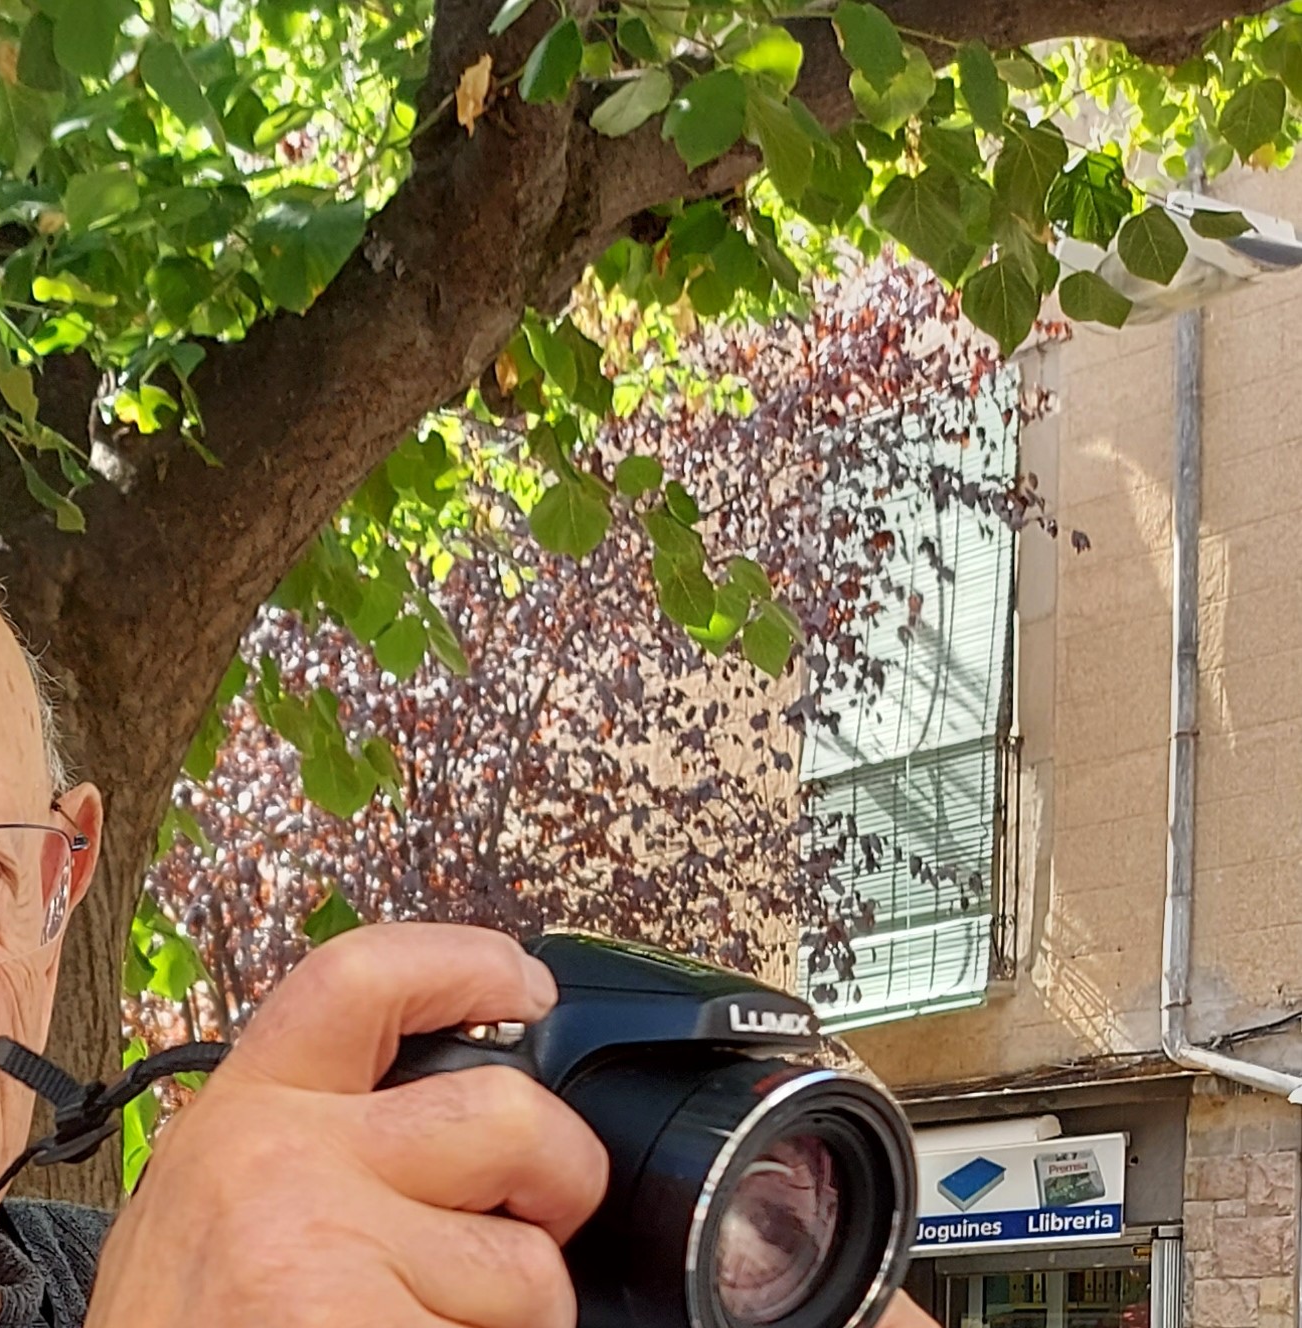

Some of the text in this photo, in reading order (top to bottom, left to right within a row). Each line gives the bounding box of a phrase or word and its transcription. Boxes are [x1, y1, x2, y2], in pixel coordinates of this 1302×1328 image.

[729, 1003, 812, 1037] LUMIX
[916, 1210, 1113, 1242] Joguines Llibreria
